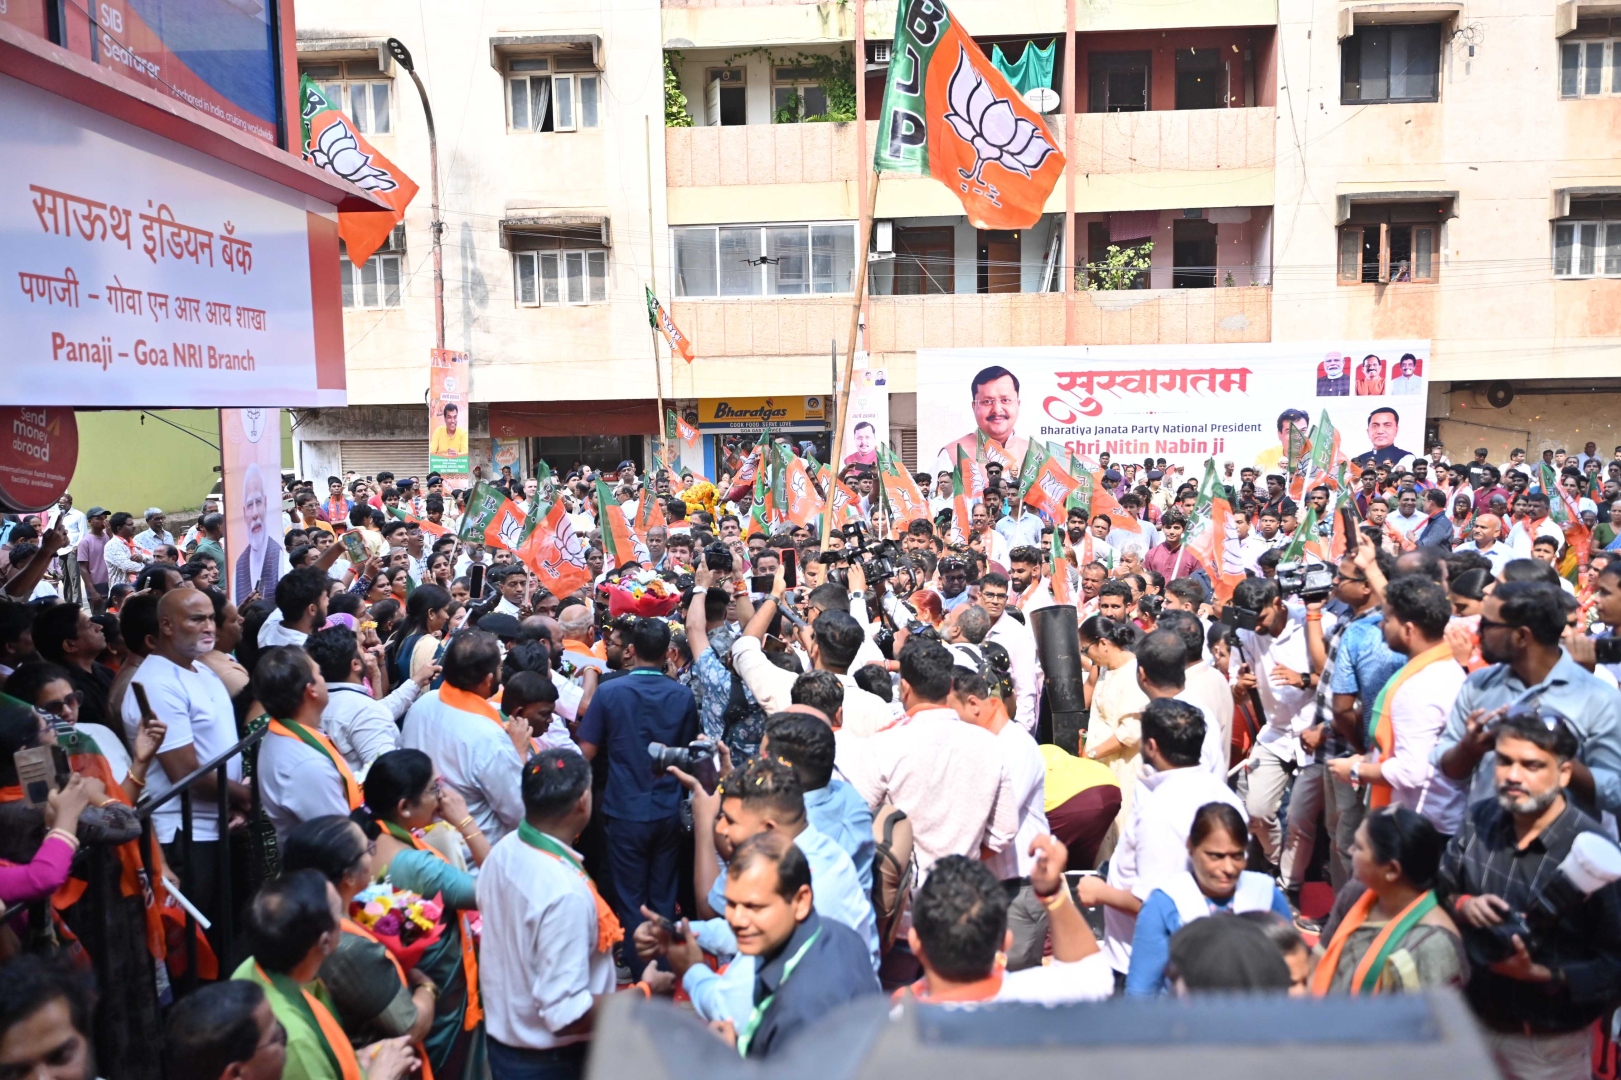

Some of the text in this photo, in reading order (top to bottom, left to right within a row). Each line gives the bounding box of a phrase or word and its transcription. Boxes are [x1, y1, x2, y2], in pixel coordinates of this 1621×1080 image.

[101, 3, 123, 33] SIB
[102, 34, 160, 80] Seafarer
[172, 84, 274, 142] Anchored in India, cruising worldwide
[29, 184, 252, 275] साऊथ इंडियन बँक
[18, 267, 79, 308] पणजी
[106, 275, 142, 316] गोवा
[147, 291, 169, 322] एन
[174, 296, 201, 322] आर
[205, 301, 231, 326] आय
[236, 305, 267, 331] शाखा
[51, 332, 113, 371] Panaji
[134, 339, 169, 367] Goa
[173, 342, 203, 368] NRI
[207, 345, 255, 371] Branch
[1042, 367, 1254, 425] सुस्वागतम
[20, 407, 46, 428] Send
[714, 402, 787, 421] Bharatgas
[13, 419, 48, 445] money
[1040, 422, 1262, 436] Bharatiya Janata Party National President
[12, 438, 49, 462] abroad
[1064, 437, 1225, 456] Shri Nitin Nabin ji
[0, 465, 33, 476] nternational
[11, 476, 54, 489] facility available
